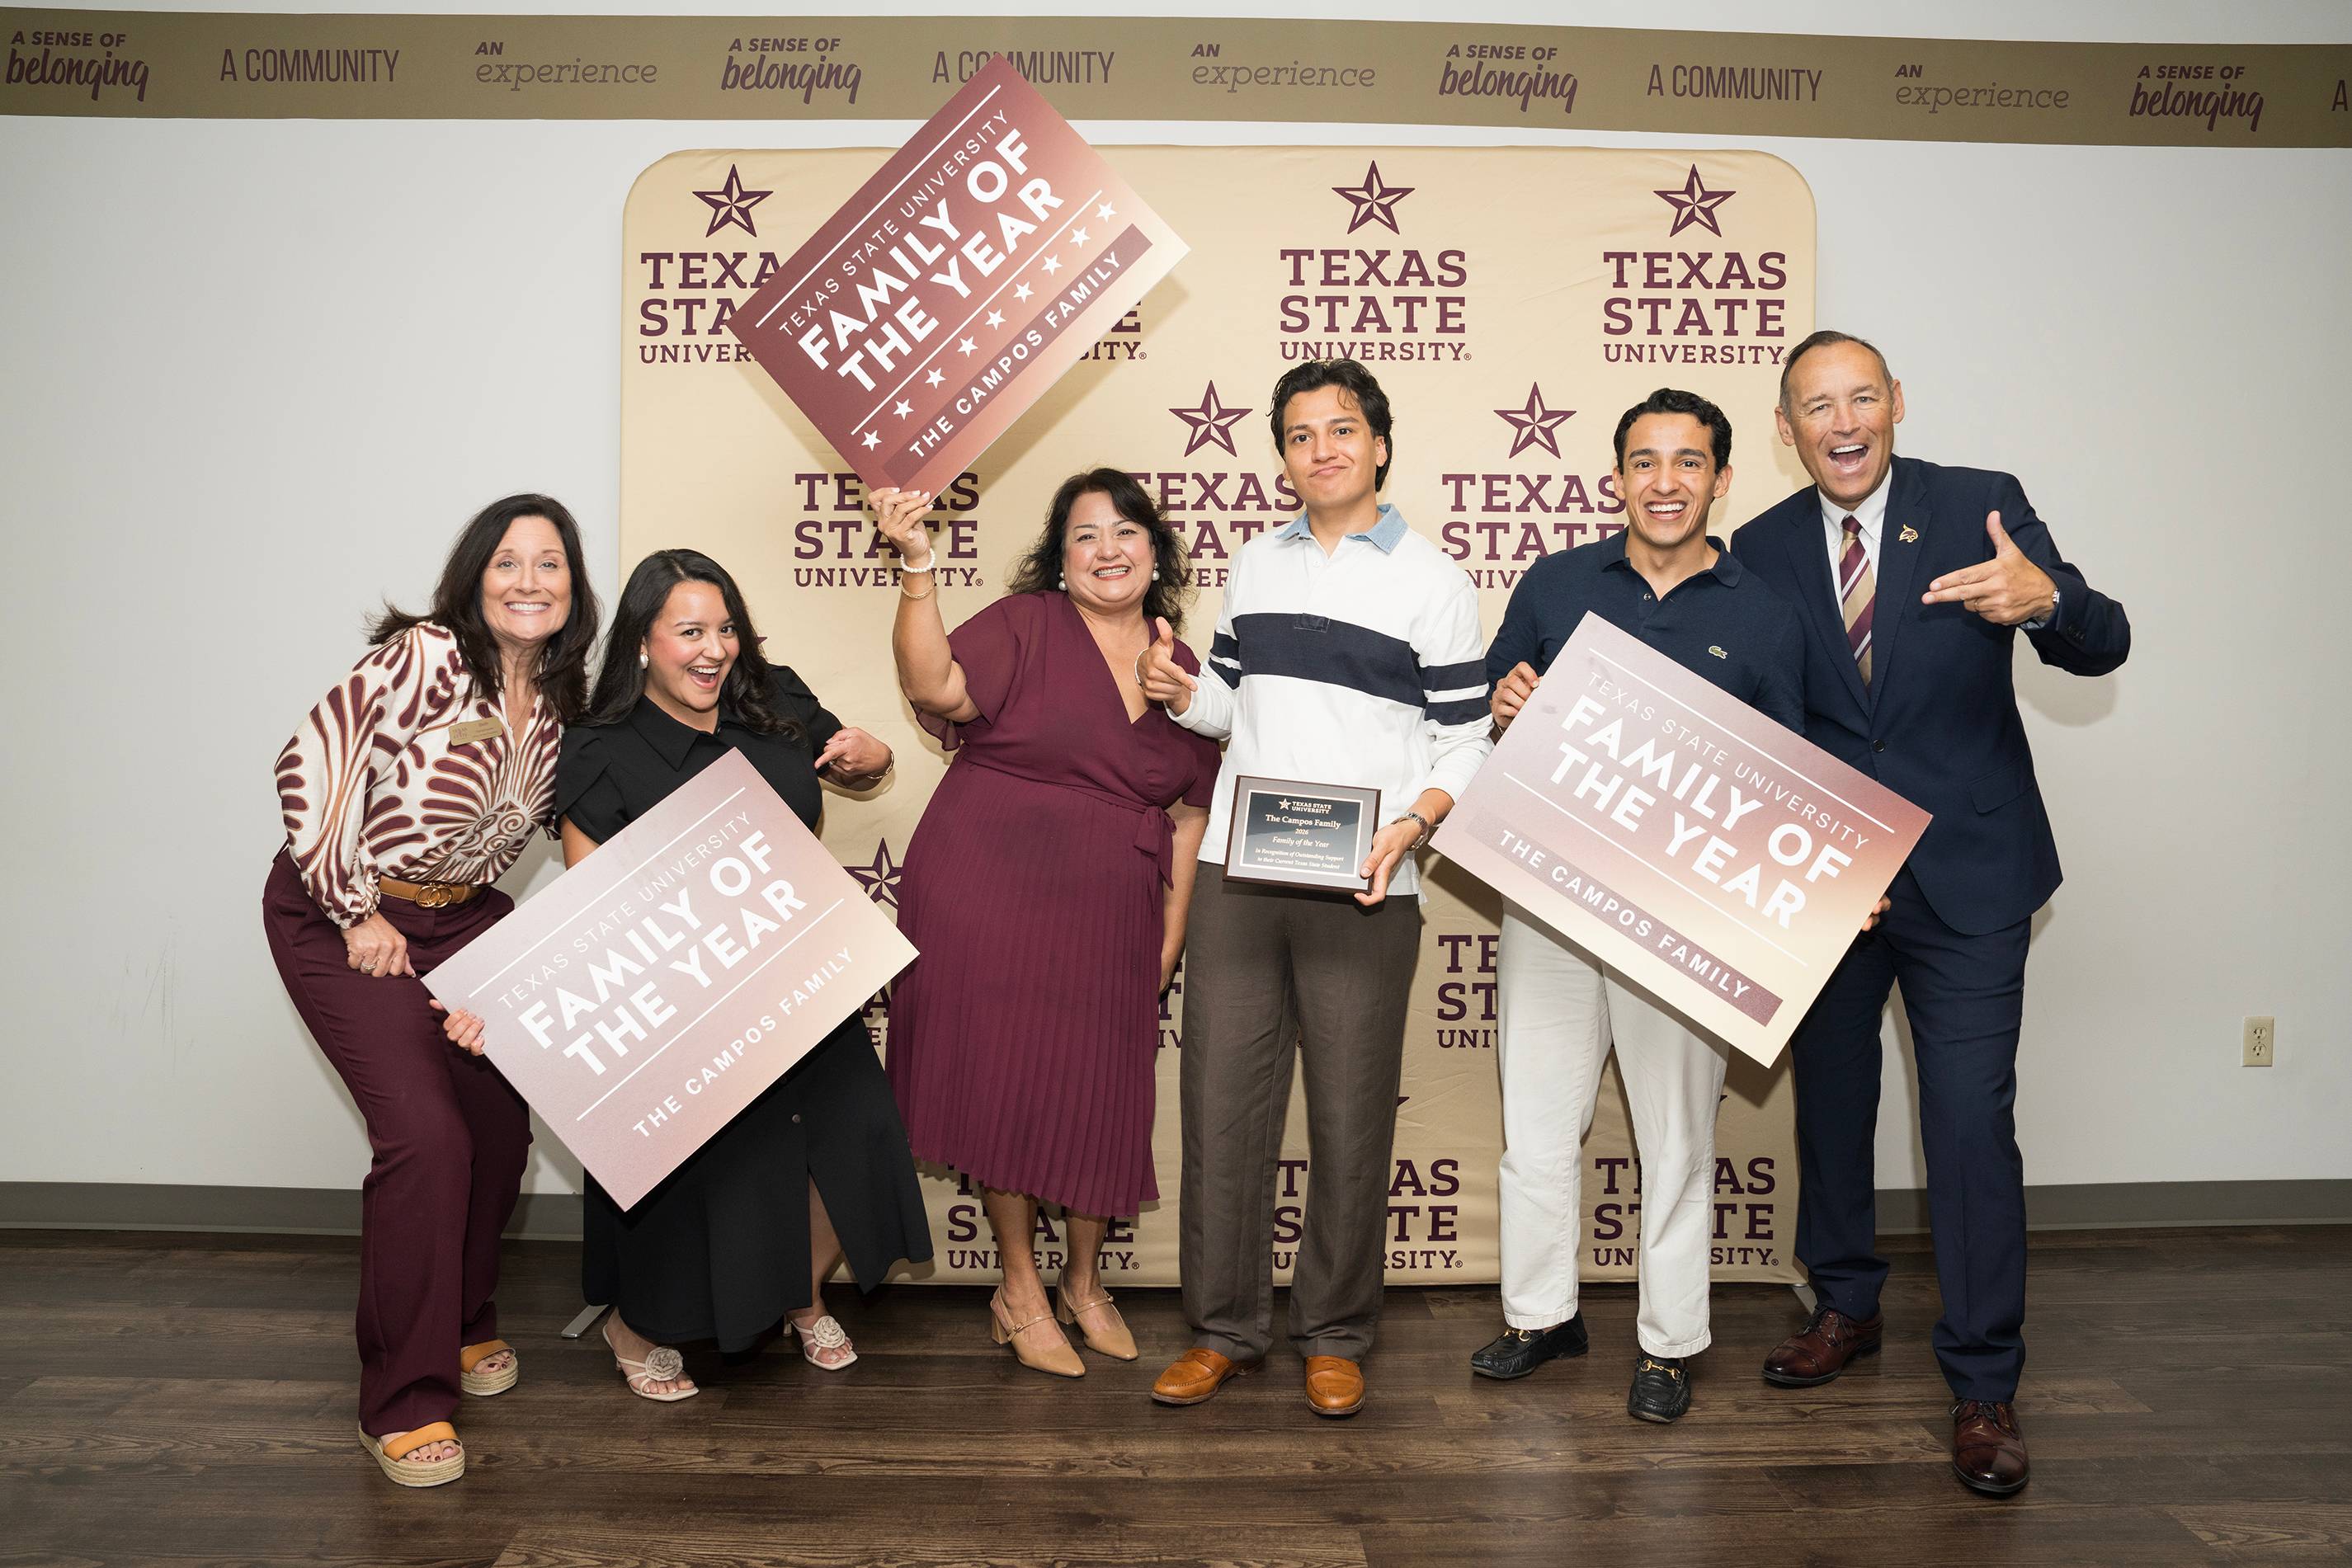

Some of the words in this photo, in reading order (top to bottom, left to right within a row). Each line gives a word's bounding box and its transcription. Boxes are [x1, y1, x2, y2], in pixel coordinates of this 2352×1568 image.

[11, 31, 26, 45] A
[31, 31, 93, 47] SENSE
[99, 32, 126, 48] OF
[474, 41, 504, 55] AN
[728, 38, 742, 52] A
[747, 37, 808, 52] SENSE
[814, 37, 841, 52] OF
[1190, 44, 1221, 58] AN
[1445, 44, 1460, 58] A
[1466, 44, 1526, 60] SENSE
[1531, 46, 1558, 61] OF
[5, 47, 149, 102] belonging
[220, 48, 238, 82] A
[245, 48, 399, 82] COMMUNITY
[475, 57, 658, 92] experience
[720, 54, 862, 105] belonging
[932, 50, 950, 83] A
[1192, 60, 1376, 93] experience
[1647, 64, 1664, 97] A
[1672, 64, 1823, 102] COMMUNITY
[1894, 64, 1923, 78] AN
[2137, 65, 2151, 79] A
[2156, 65, 2215, 80] SENSE
[2219, 65, 2246, 80] OF
[1438, 60, 1578, 114] belonging
[1896, 82, 2070, 114] experience
[2331, 80, 2348, 111] A
[2129, 81, 2265, 133] belonging
[779, 278, 839, 336] TEXAS
[842, 220, 899, 275] STATE
[900, 110, 1007, 218] UNIVERSITY
[798, 198, 960, 370] FAMILY
[967, 128, 1028, 203] OF
[1280, 249, 1467, 287] TEXAS
[641, 252, 780, 289] TEXA
[837, 295, 940, 392] THE
[930, 178, 1064, 299] YEAR
[1603, 252, 1786, 290] TEXAS
[640, 299, 738, 337] STA
[1280, 295, 1465, 333] STATE
[1604, 298, 1784, 337] STATE
[909, 416, 954, 457] THE
[956, 330, 1043, 414] CAMPOS
[1044, 251, 1120, 328] FAMILY
[795, 473, 979, 511] TES
[1442, 474, 1626, 513] TEXAS
[794, 520, 978, 559] STAE
[1588, 672, 1654, 720] TEXAS
[1661, 719, 1729, 765] STATE
[1735, 762, 1869, 850] UNIVERSITY
[1561, 695, 1764, 831] FAMILY
[1768, 823, 1852, 883] OF
[1266, 814, 1280, 822] The
[1282, 816, 1313, 826] Campos
[1314, 819, 1341, 829] Family
[1550, 742, 1656, 833] THE
[1665, 811, 1806, 930] YEAR
[1272, 836, 1294, 845] Family
[1295, 839, 1303, 847] of
[497, 954, 568, 1009] TEXAS
[573, 902, 636, 953] STATE
[639, 812, 750, 902] UNIVERSITY
[1499, 830, 1546, 869] THE
[1552, 866, 1652, 937] CAMPOS
[1658, 934, 1750, 998] FAMILY
[517, 887, 701, 1049] FAMILY
[709, 830, 772, 897] OF
[563, 981, 677, 1076] THE
[669, 879, 808, 988] YEAR
[633, 1095, 682, 1137] THE
[686, 1015, 776, 1095] CAMPOS
[779, 947, 852, 1015] FAMILY
[1278, 1159, 1459, 1197] TAS
[1595, 1157, 1775, 1195] TAS
[1274, 1206, 1458, 1243] STE
[1594, 1203, 1774, 1240] STE
